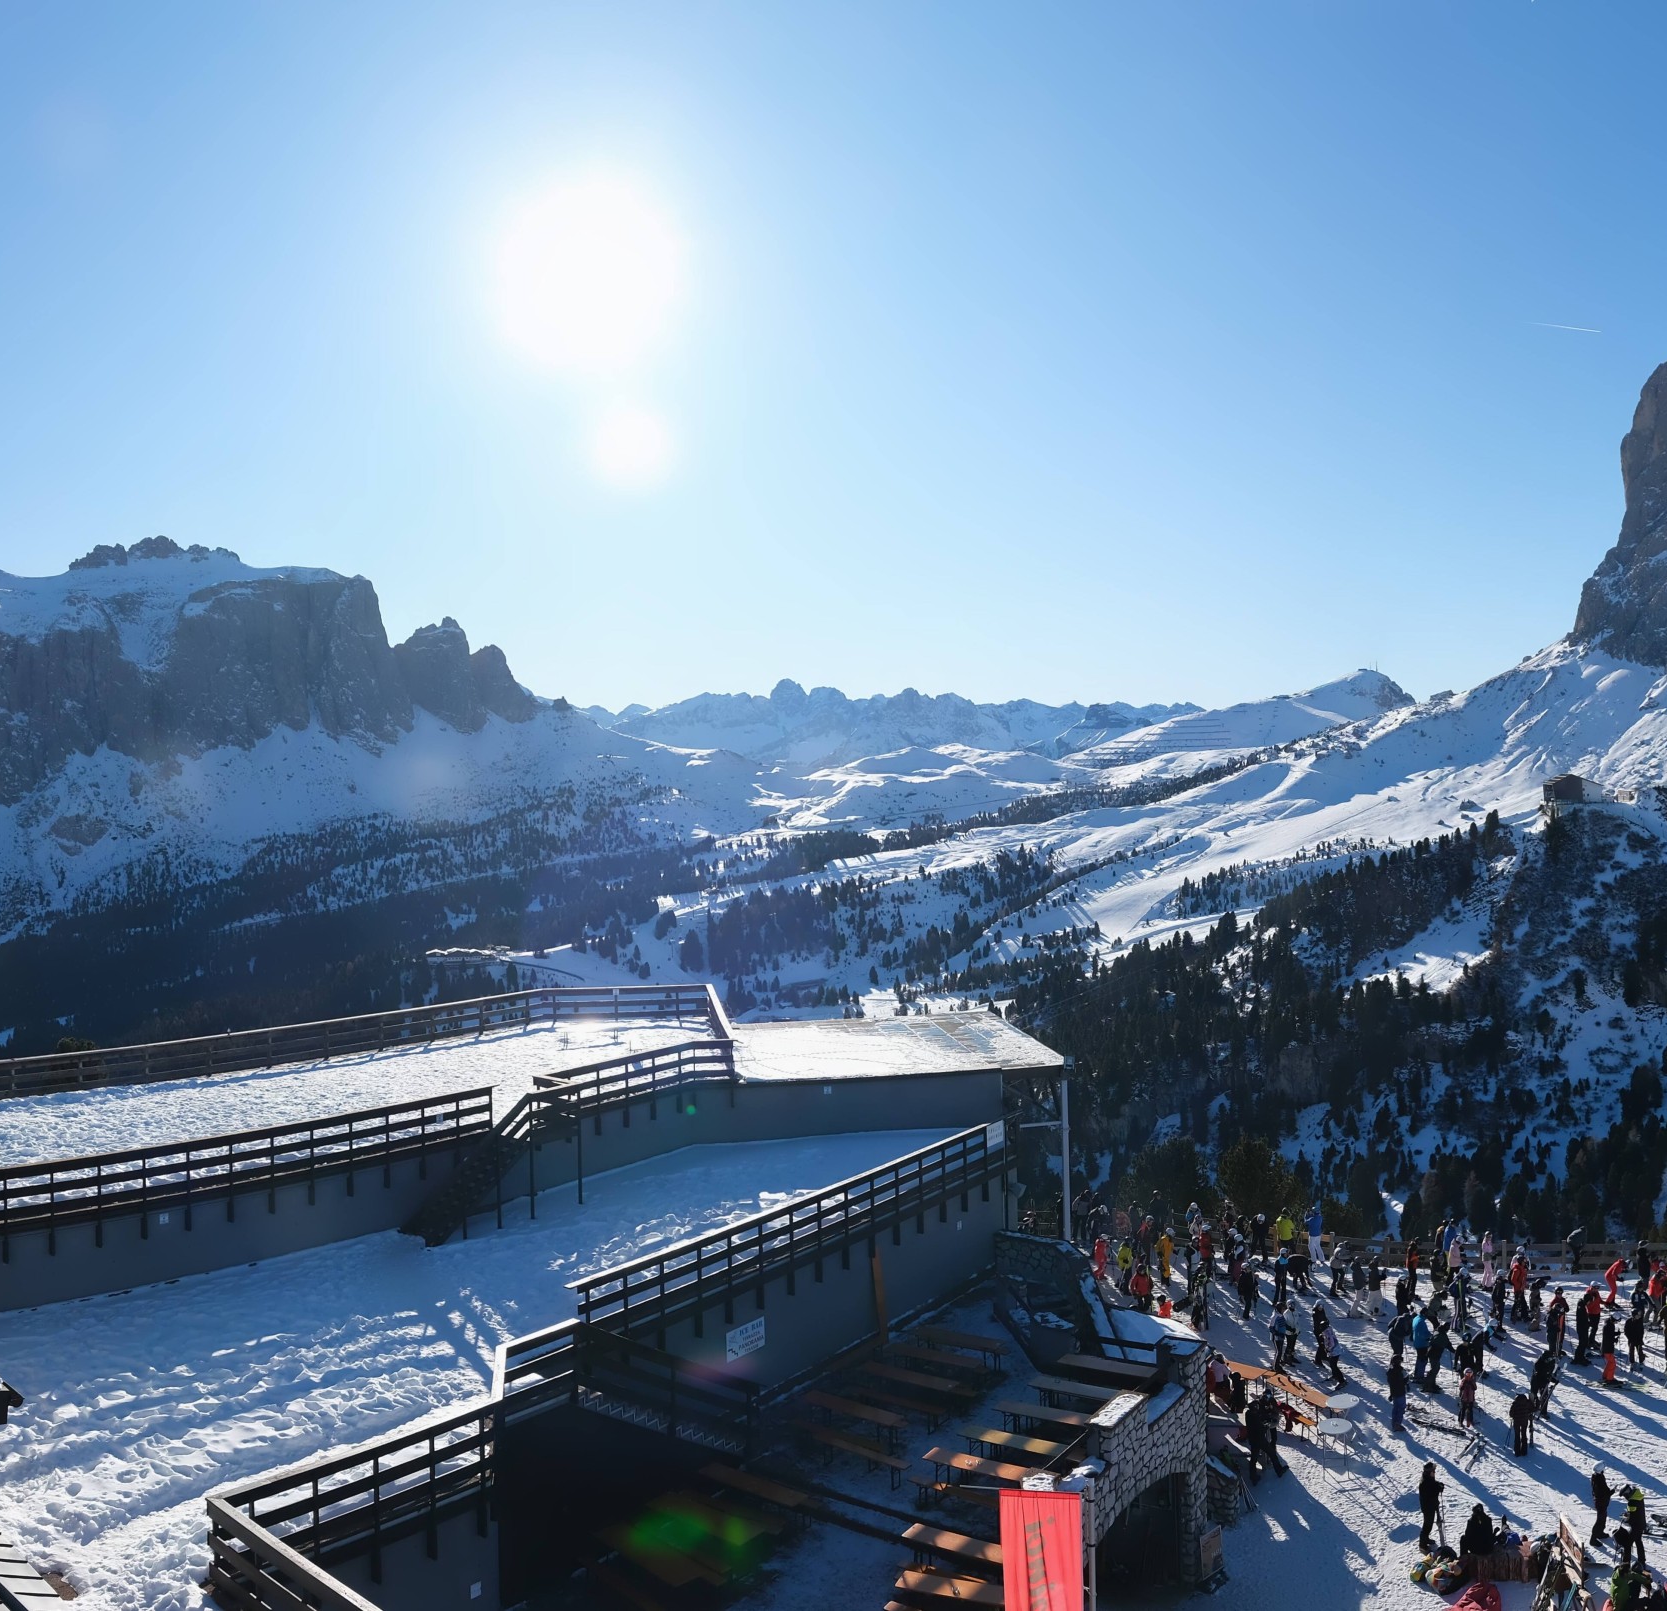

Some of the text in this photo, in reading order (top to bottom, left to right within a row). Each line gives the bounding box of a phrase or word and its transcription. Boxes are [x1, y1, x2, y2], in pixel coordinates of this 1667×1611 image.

[739, 1320, 763, 1336] ICE BAR
[738, 1334, 764, 1350] PANORAMA
